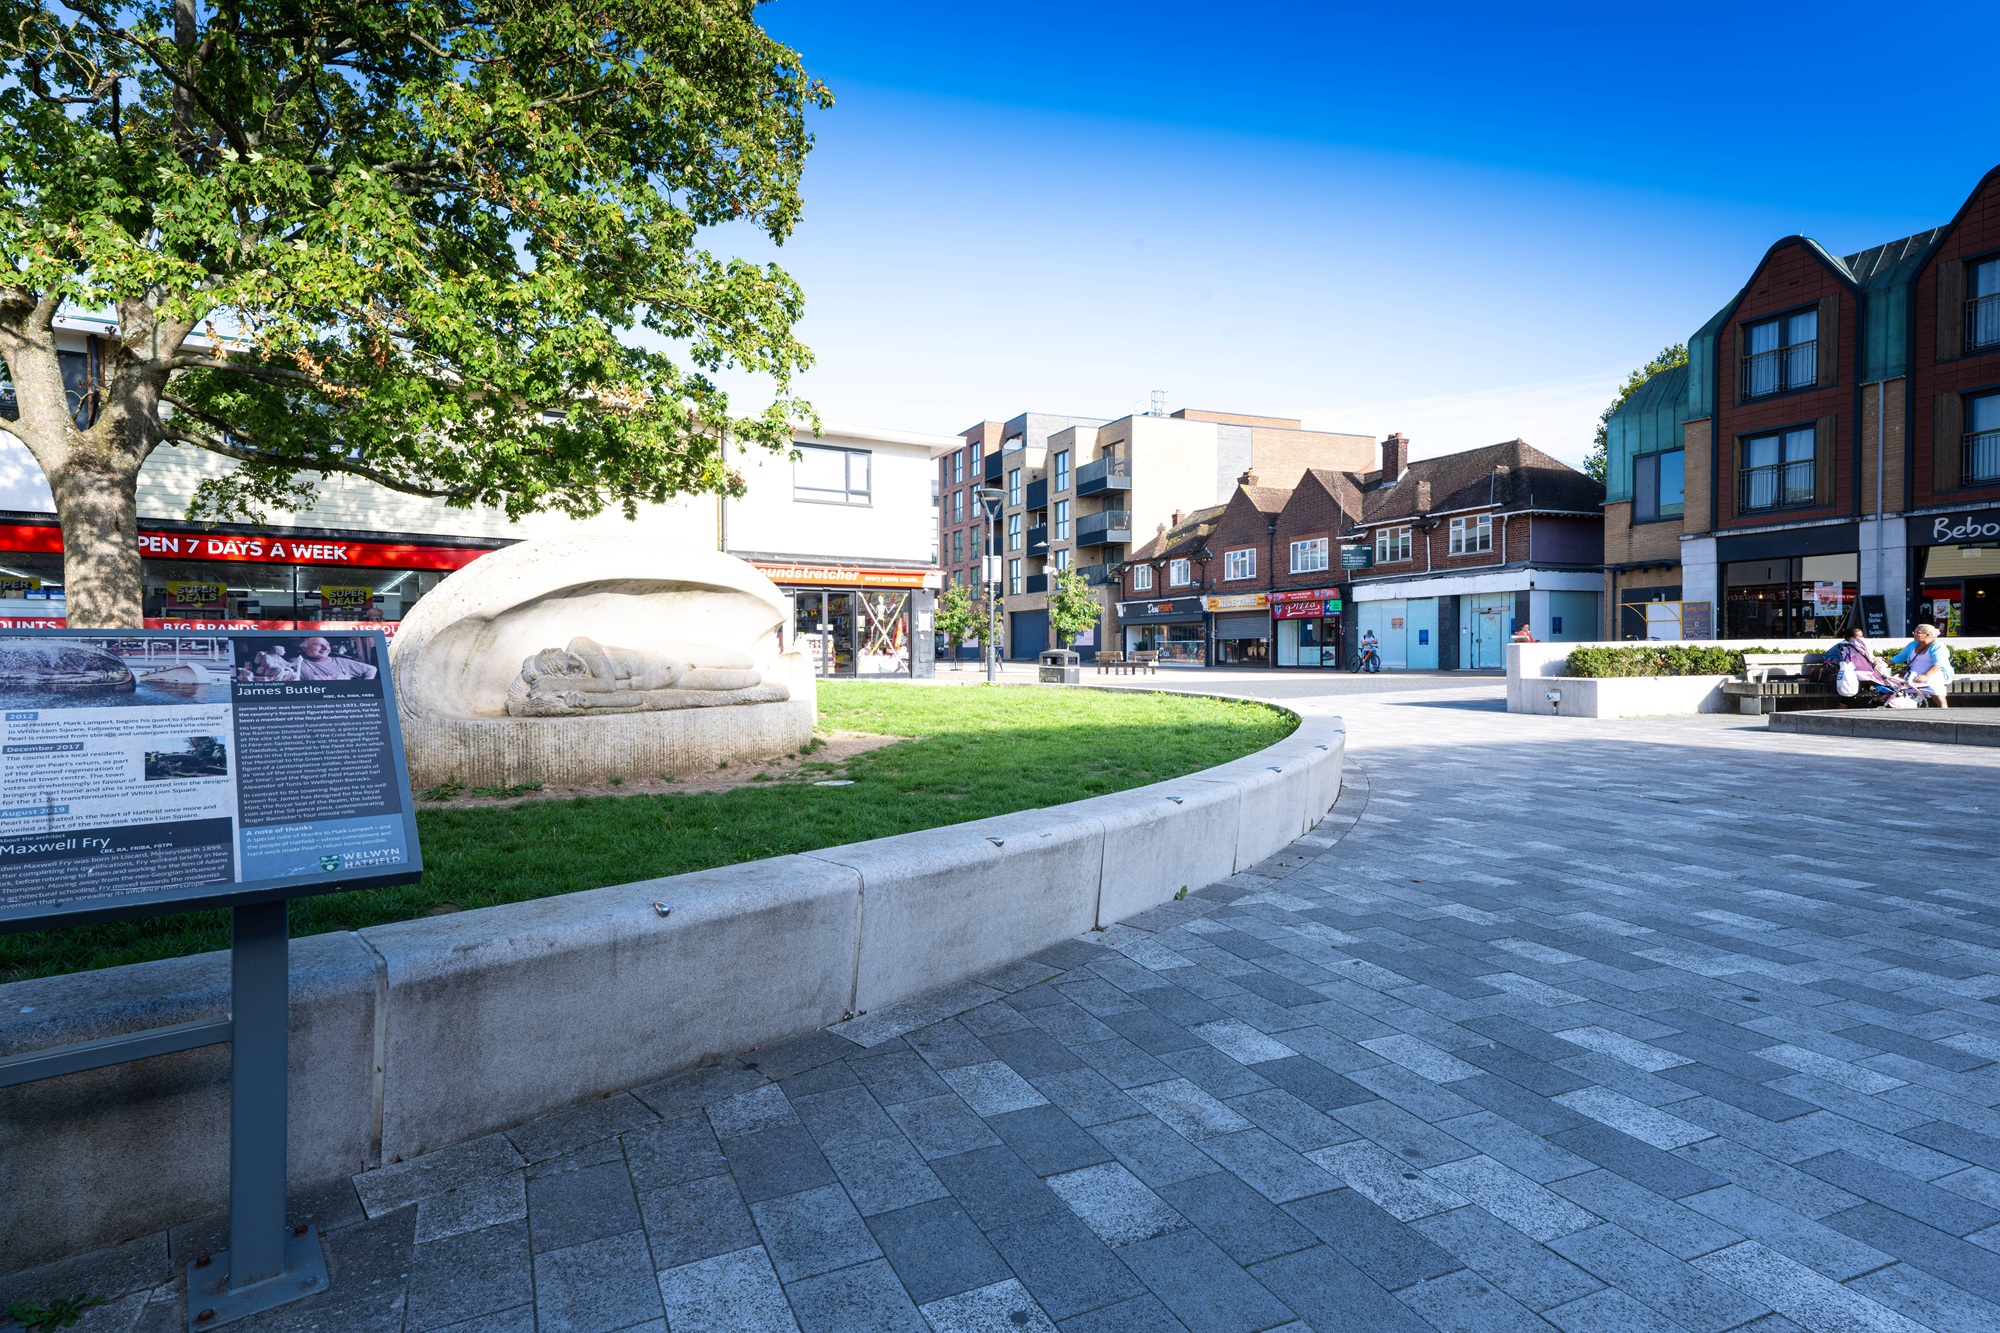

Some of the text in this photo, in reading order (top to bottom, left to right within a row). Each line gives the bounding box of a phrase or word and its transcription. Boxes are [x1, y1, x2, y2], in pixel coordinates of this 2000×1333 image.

[138, 535, 348, 560] PEN 7 DAYS A WEEK
[760, 568, 860, 580] oundstretcher
[177, 585, 218, 594] SUPER
[176, 592, 217, 603] DEALS
[330, 590, 365, 598] SUPER
[329, 597, 365, 606] DEALS
[0, 621, 56, 629] OUNTS
[237, 685, 326, 696] James Butler
[7, 745, 54, 753] December
[64, 766, 114, 774] regeneration
[28, 781, 90, 789] overwhelmingly
[61, 793, 119, 801] transformation
[1, 809, 37, 817] August
[32, 815, 73, 823] reinstated
[93, 818, 128, 826] new-look
[0, 838, 110, 855] Maxwell Fry
[343, 848, 400, 860] WELWYN
